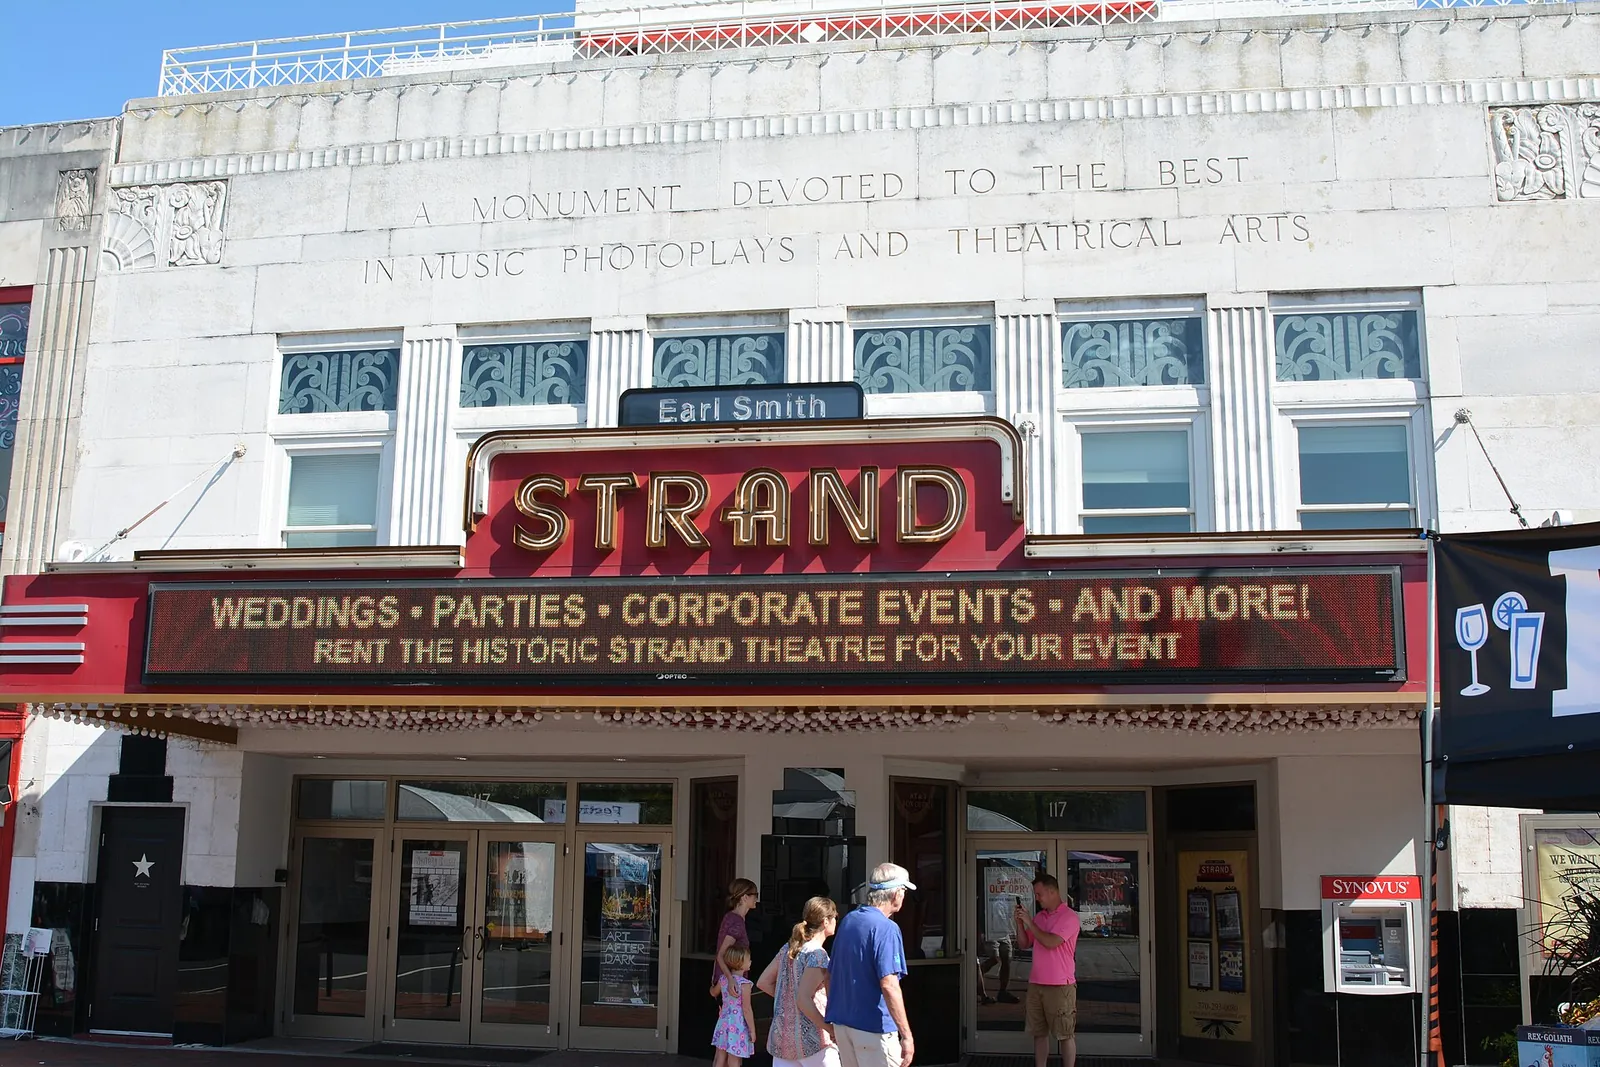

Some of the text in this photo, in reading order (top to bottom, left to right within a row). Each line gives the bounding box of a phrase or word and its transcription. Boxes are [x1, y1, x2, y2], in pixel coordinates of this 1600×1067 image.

[414, 156, 1249, 225] A MONUMENT DEVOTED TO THE BEST
[363, 214, 1311, 284] IN MUSIC PHOTOPLAYS AND THEATRICAL ARTS
[659, 394, 827, 423] Earl Smith
[513, 464, 969, 550] STRAND
[211, 583, 1310, 629] WEDDINGS PARTIES CORPORATE EVENTS AND MORE!
[313, 631, 1181, 664] RENT THE HISTORIC STRAND THEATRE FOR YOUR EVENT
[1049, 801, 1067, 818] 117
[1550, 854, 1566, 865] WE
[1333, 879, 1407, 894] SYNOVUS
[604, 943, 645, 954] AFTER
[605, 932, 630, 942] ART
[604, 954, 637, 965] DARK
